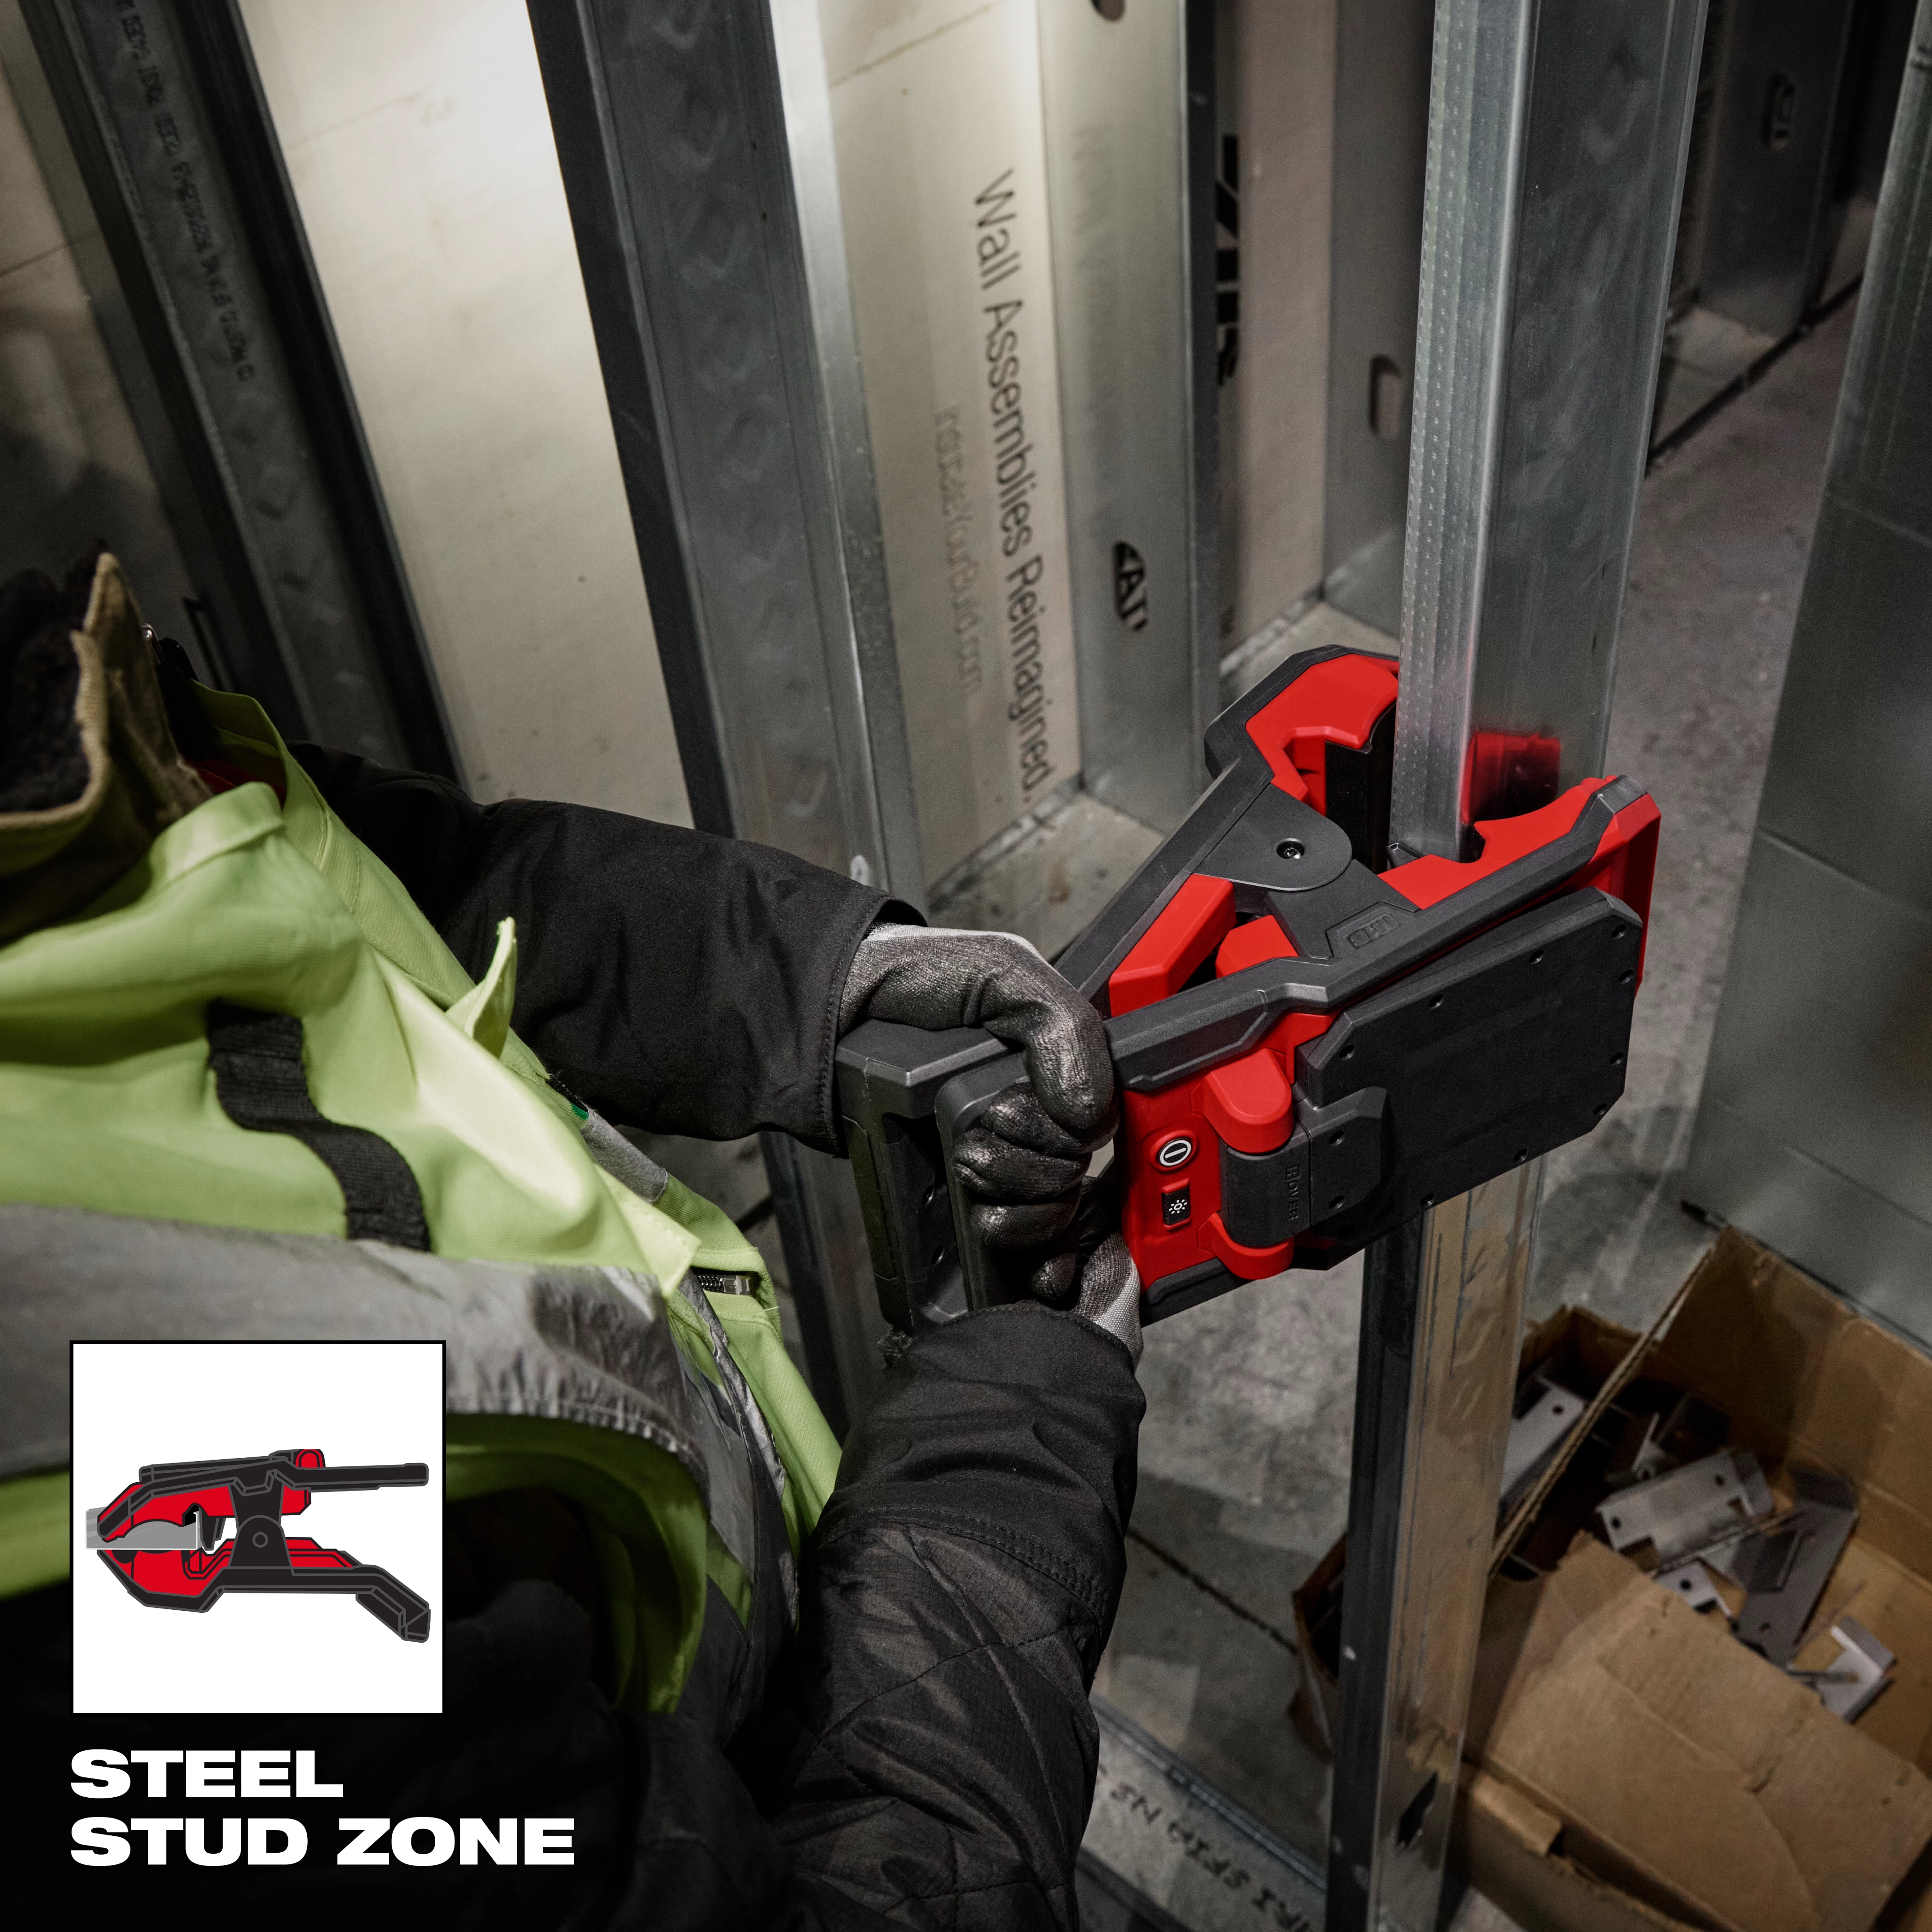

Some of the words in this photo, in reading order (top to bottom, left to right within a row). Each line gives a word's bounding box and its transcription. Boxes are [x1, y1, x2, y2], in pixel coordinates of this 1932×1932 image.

[975, 168, 1021, 290] Wall
[982, 298, 1037, 558] Assemblies
[1006, 553, 1057, 804] Reimagined.
[1285, 1165, 1300, 1222] ROVER
